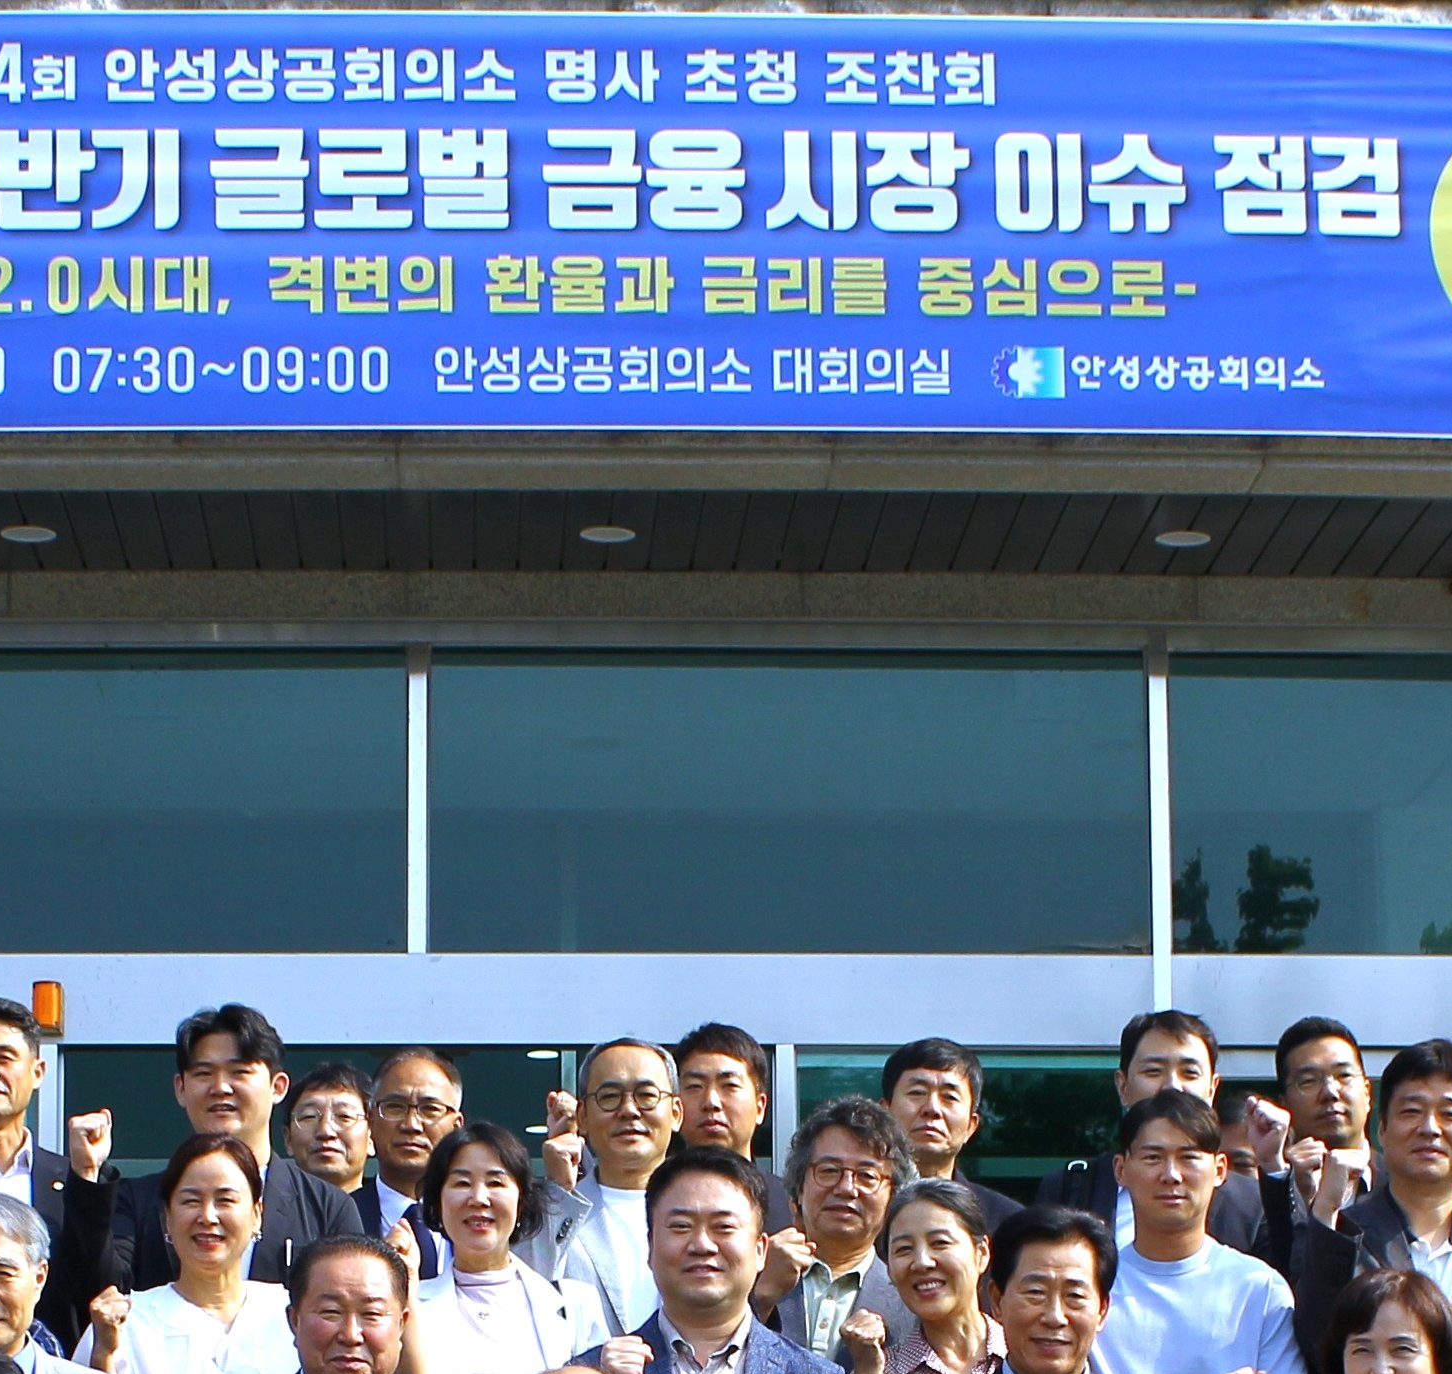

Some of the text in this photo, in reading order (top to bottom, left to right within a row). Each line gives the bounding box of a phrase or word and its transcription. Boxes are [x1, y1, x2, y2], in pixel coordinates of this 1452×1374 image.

[106, 49, 516, 101] 안성상공회의소
[547, 51, 660, 101] 명사
[687, 50, 797, 102] 초청
[827, 52, 996, 105] 조찬회
[211, 129, 510, 228] 글로벌
[544, 130, 746, 229] 금융
[768, 131, 970, 231] 시장
[996, 133, 1186, 232] 이슈
[1215, 136, 1401, 236] 점검
[270, 257, 453, 313] 격변의
[487, 256, 675, 312] 환율과
[703, 258, 887, 314] 금리를
[55, 347, 389, 393] 07:30~09:00
[436, 347, 752, 392] 안성상공회의소
[773, 347, 951, 395] 대회의실
[1073, 357, 1325, 391] 안성상공회의소
